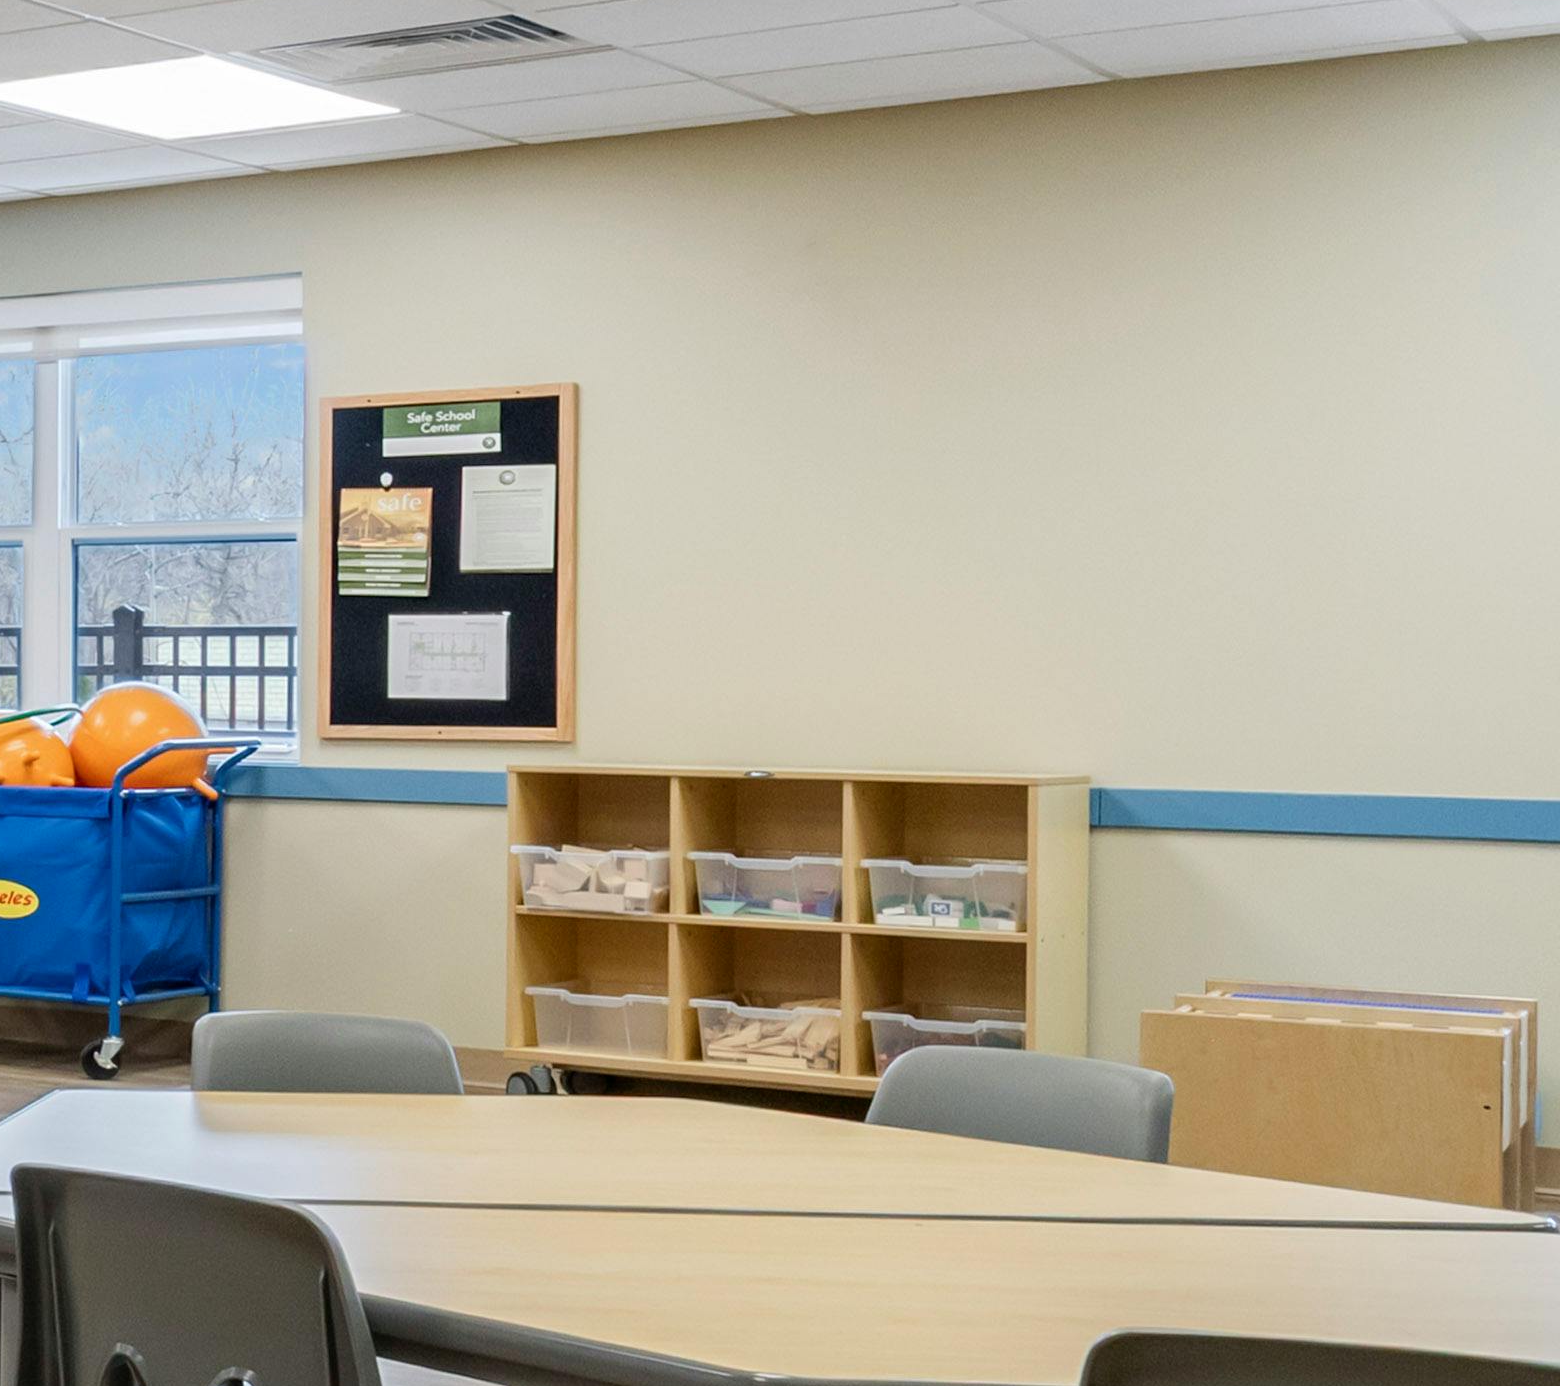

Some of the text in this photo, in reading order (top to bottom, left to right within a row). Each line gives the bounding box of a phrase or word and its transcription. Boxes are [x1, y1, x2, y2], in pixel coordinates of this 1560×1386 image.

[406, 408, 476, 424] Safe School
[420, 422, 462, 434] Center
[377, 492, 422, 512] safe
